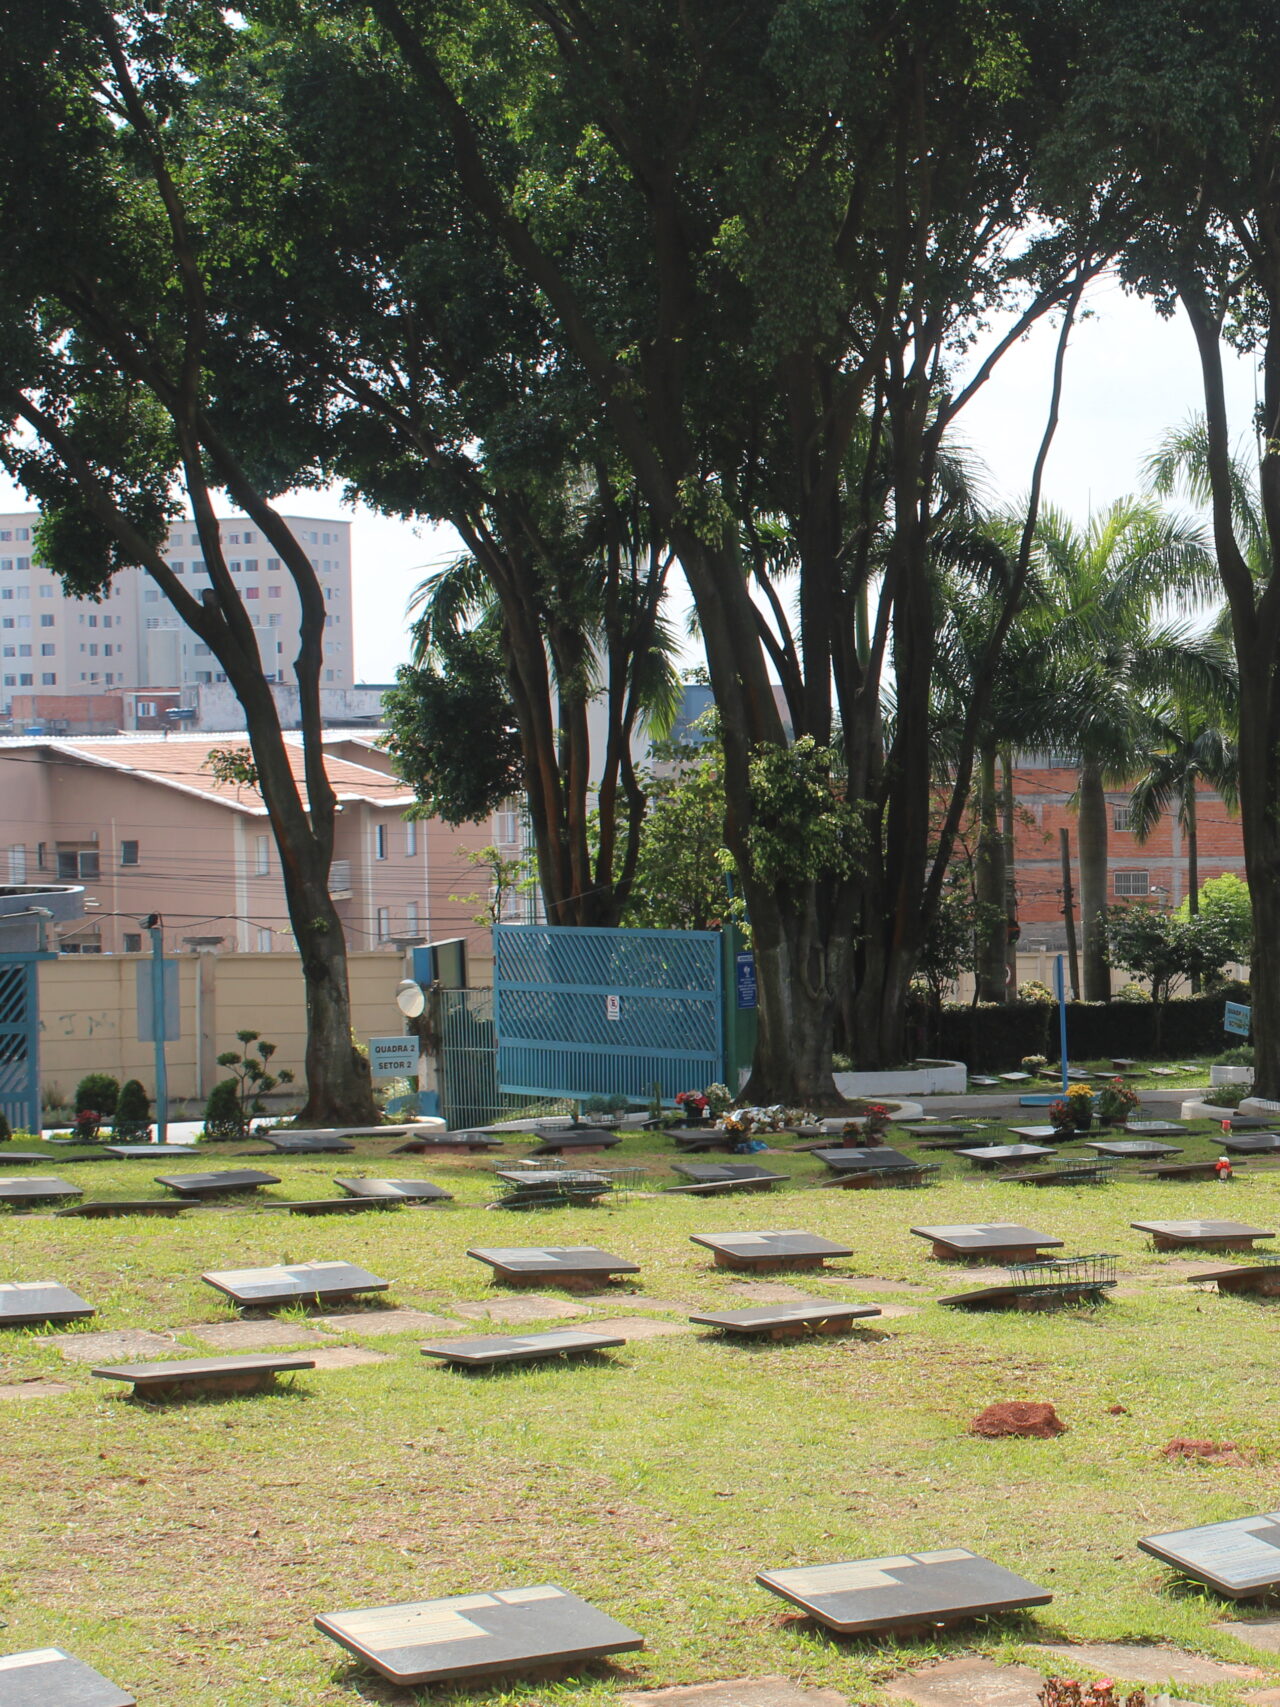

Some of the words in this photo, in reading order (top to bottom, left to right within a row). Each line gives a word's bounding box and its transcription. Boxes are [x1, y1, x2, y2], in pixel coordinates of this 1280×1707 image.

[375, 1045, 408, 1053] QUADRA
[410, 1044, 415, 1052] 2
[378, 1061, 405, 1070] SETOR
